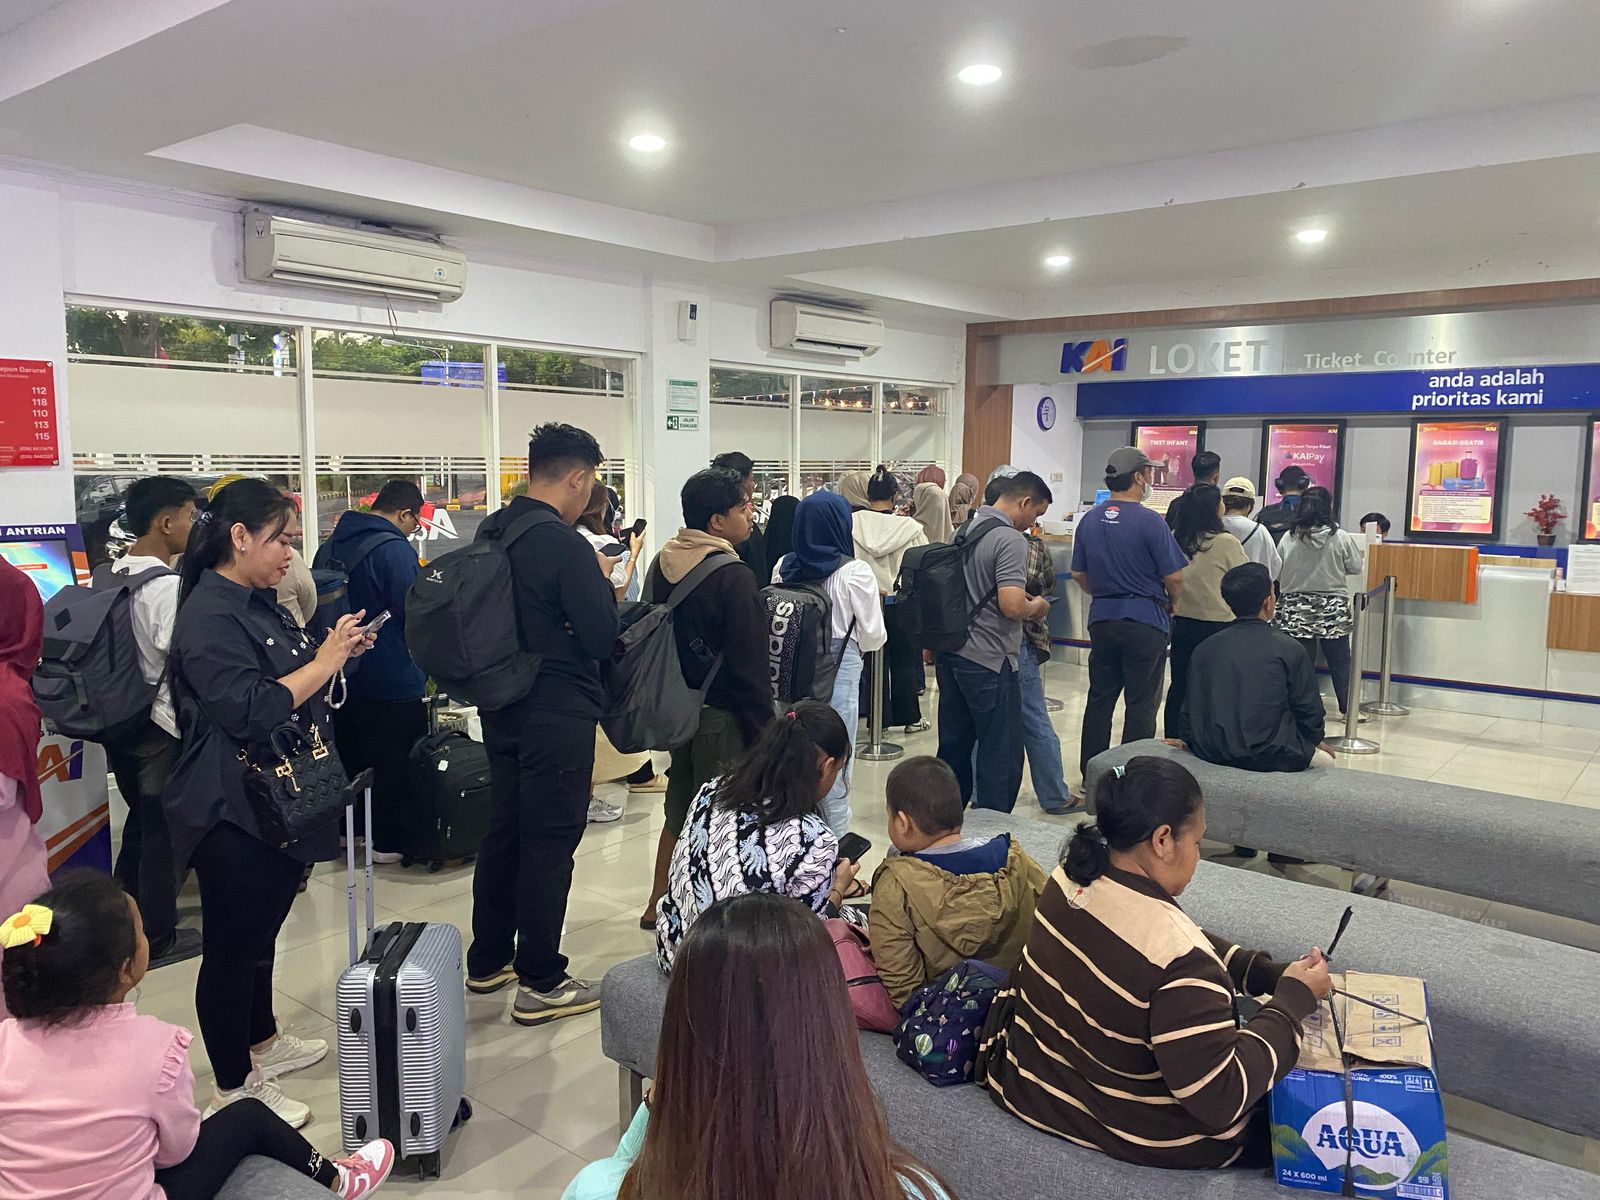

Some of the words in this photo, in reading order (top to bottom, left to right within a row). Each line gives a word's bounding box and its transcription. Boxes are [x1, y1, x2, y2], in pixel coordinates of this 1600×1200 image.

[1060, 338, 1128, 374] KAI
[1149, 340, 1270, 375] LOKET
[1304, 352, 1362, 369] Ticket
[1374, 349, 1457, 367] Conter
[1428, 371, 1474, 388] anda
[1479, 368, 1545, 387] adalah
[32, 386, 48, 395] 112
[32, 398, 48, 407] 118
[1411, 391, 1491, 411] prioritas
[1496, 389, 1544, 406] kami
[32, 409, 48, 418] 110
[34, 421, 49, 429] 113
[34, 432, 50, 441] 115
[1293, 452, 1325, 464] KAIPay
[6, 526, 66, 536] ANTRIAN
[37, 740, 84, 785] AI
[1316, 1124, 1406, 1159] AQUA
[1300, 1172, 1317, 1180] 600
